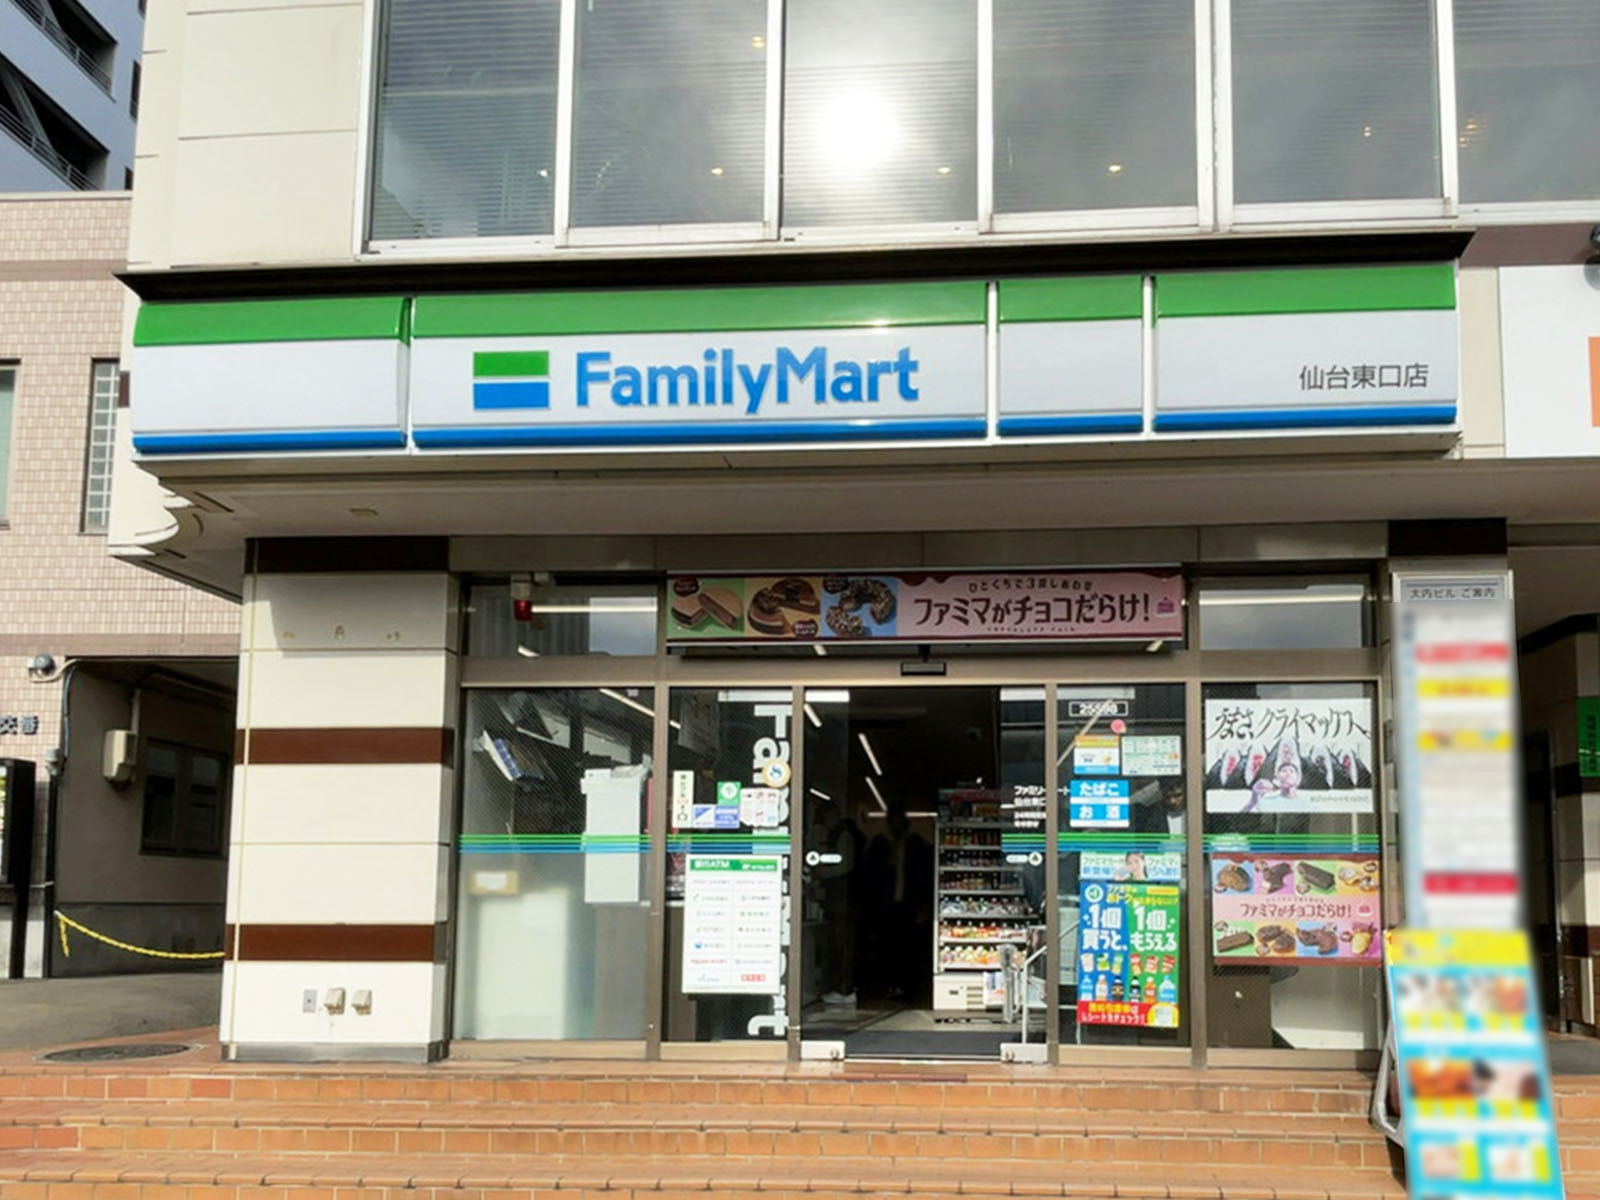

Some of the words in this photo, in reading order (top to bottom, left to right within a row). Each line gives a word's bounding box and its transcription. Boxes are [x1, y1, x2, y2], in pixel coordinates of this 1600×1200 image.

[576, 346, 919, 415] FamilyMart
[1299, 362, 1429, 391] 仙台東口店
[1079, 781, 1120, 797] たばこ
[1088, 903, 1122, 930] 1個
[1134, 905, 1167, 932] 1個
